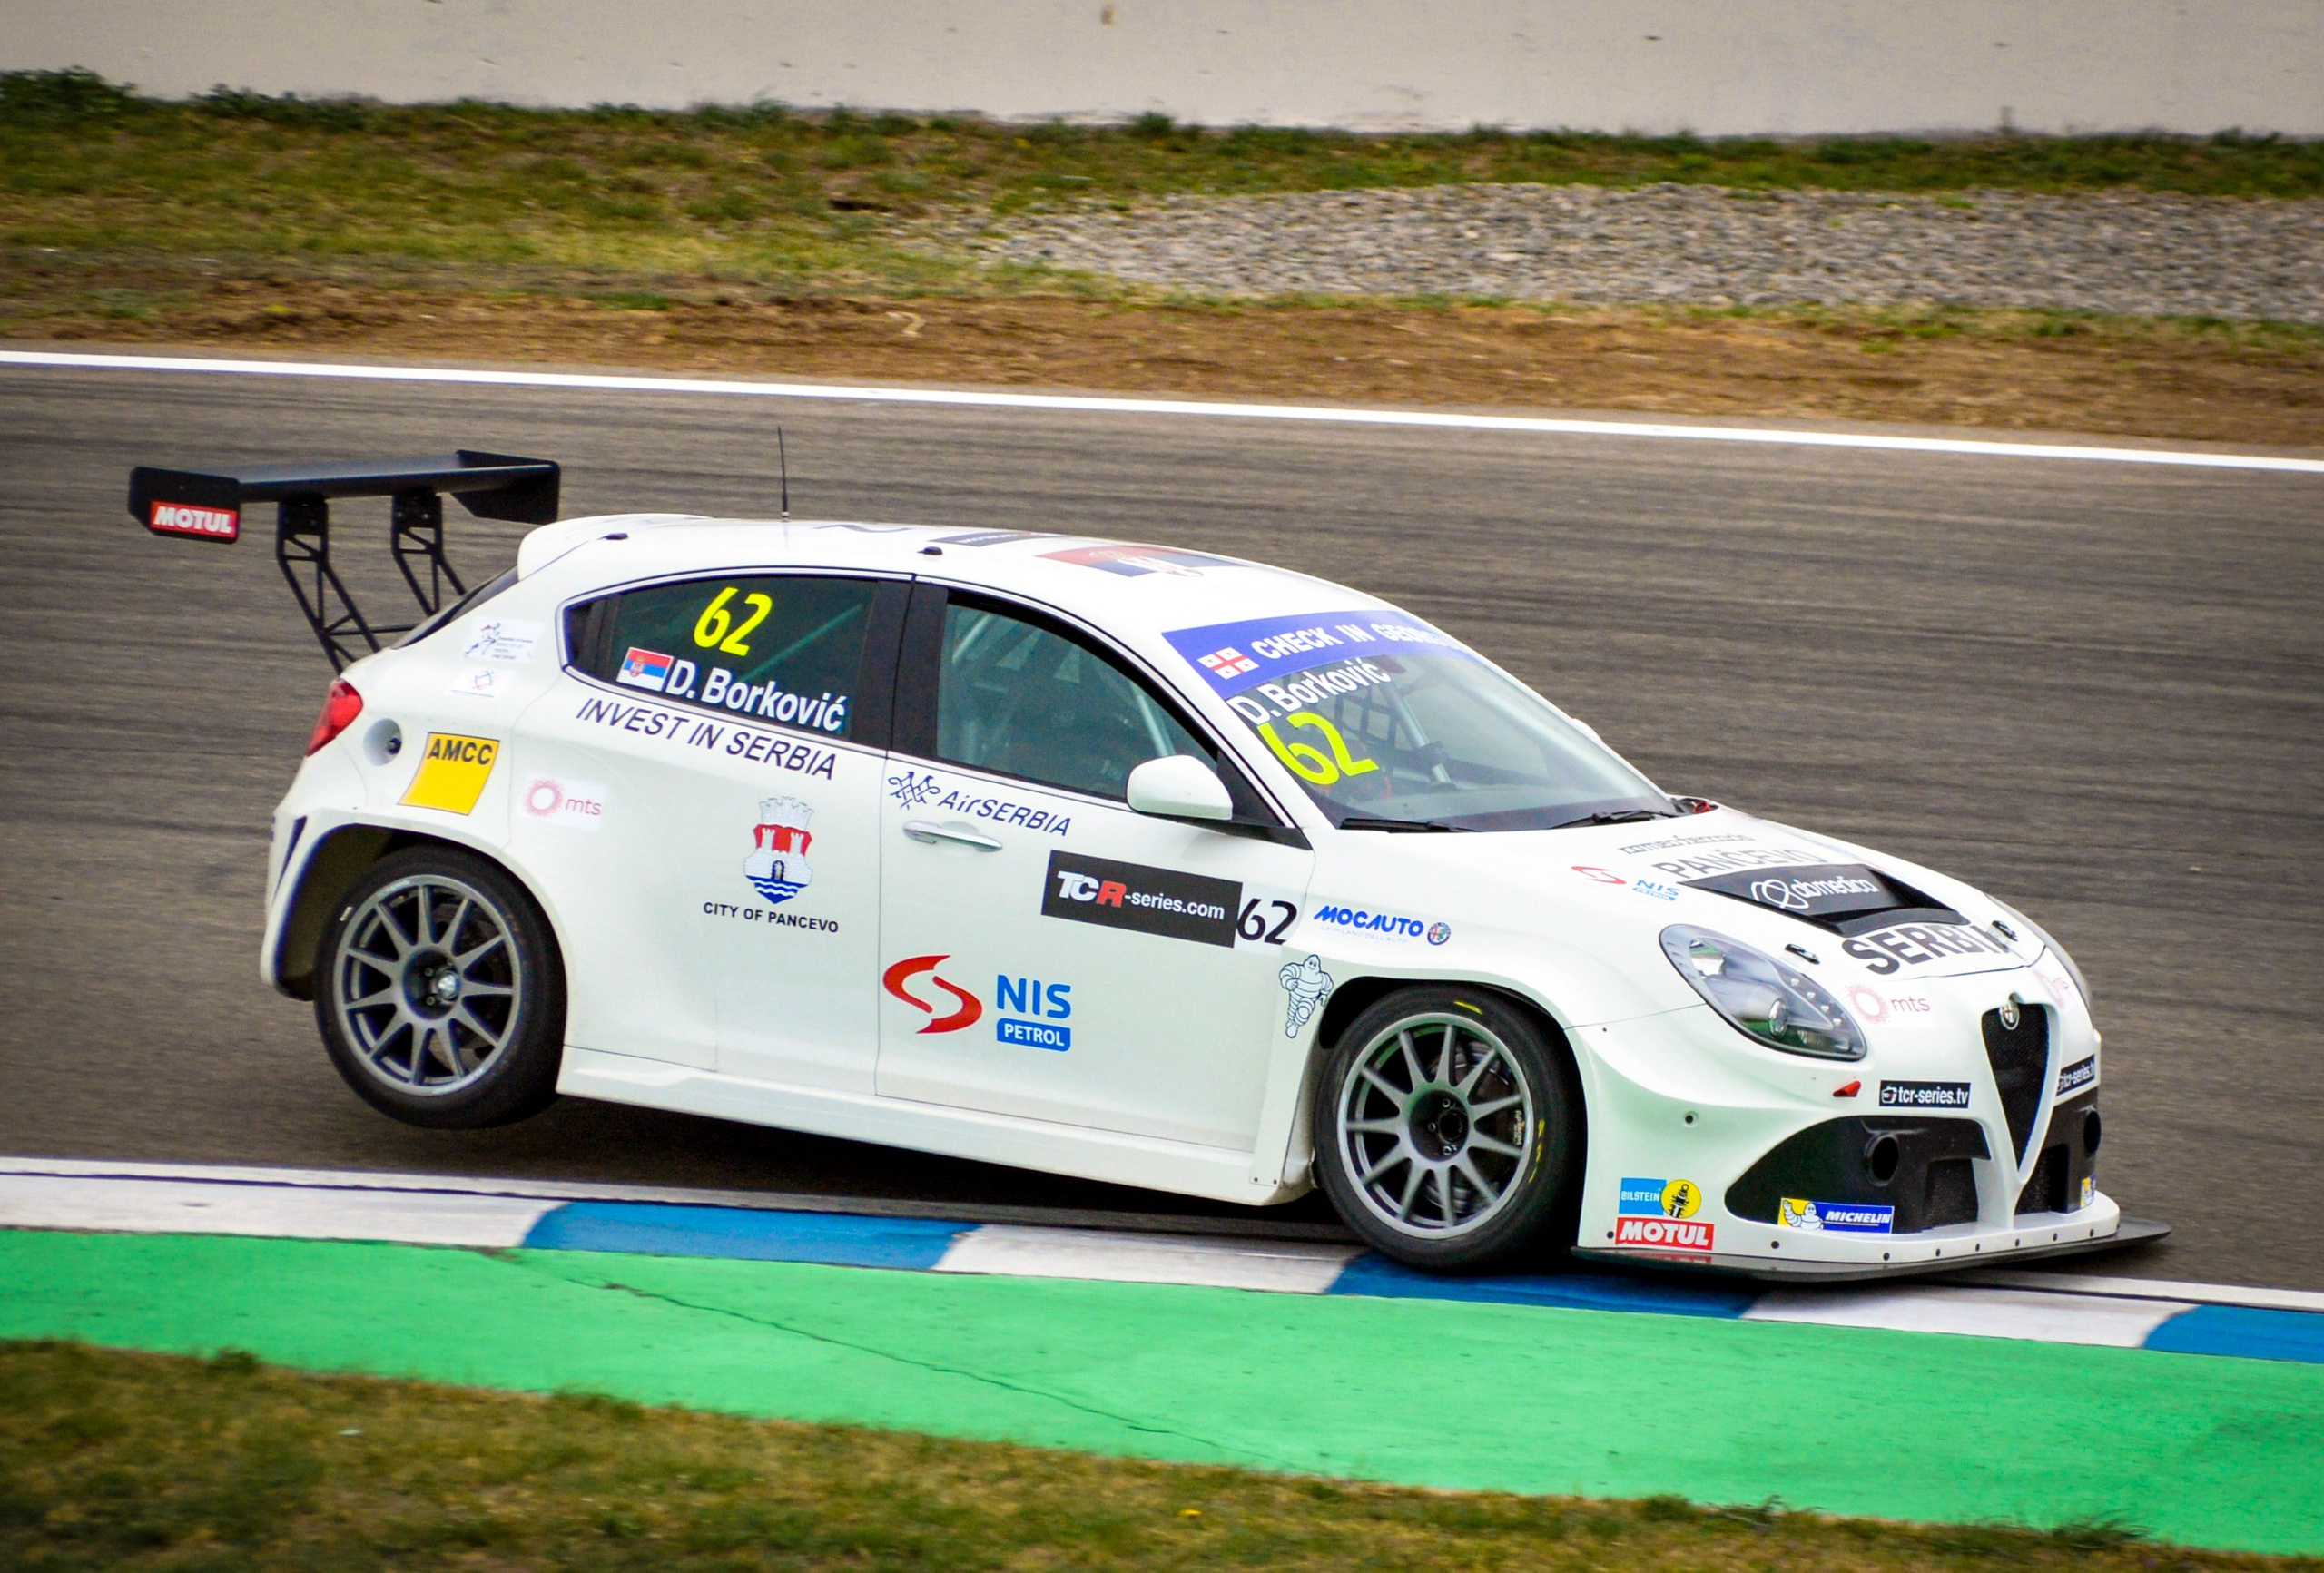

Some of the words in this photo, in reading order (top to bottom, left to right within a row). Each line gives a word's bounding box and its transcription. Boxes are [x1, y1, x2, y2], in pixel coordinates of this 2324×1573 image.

[153, 506, 232, 534] MOTUL
[694, 586, 773, 657] 62
[1250, 627, 1344, 659] CHECK
[1335, 624, 1376, 644] IN
[665, 659, 695, 699] D.
[700, 667, 848, 732] Borković
[1226, 695, 1281, 725] D.
[1258, 658, 1392, 712] Borković
[427, 738, 493, 765] AMCC
[576, 697, 690, 740] INVEST
[687, 723, 725, 750] IN
[725, 732, 837, 781] SERBIA
[1256, 712, 1379, 786] 62
[565, 797, 603, 816] mts
[1057, 870, 1226, 920] TCR-series.com
[1636, 880, 1681, 896] NIS
[703, 902, 739, 918] CITY
[743, 909, 763, 921] OF
[767, 911, 839, 933] PANCEVO
[1236, 898, 1298, 945] 62
[1313, 905, 1424, 937] MOCAUTO
[997, 974, 1072, 1019] NIS
[1891, 995, 1931, 1013] mts
[1004, 1023, 1066, 1047] PETROL
[1897, 1086, 1969, 1106] tcr-series.tv
[1620, 1191, 1660, 1203] BILSTEIN
[1825, 1210, 1892, 1224] MICHELIN
[1619, 1221, 1710, 1246] MOTUL
